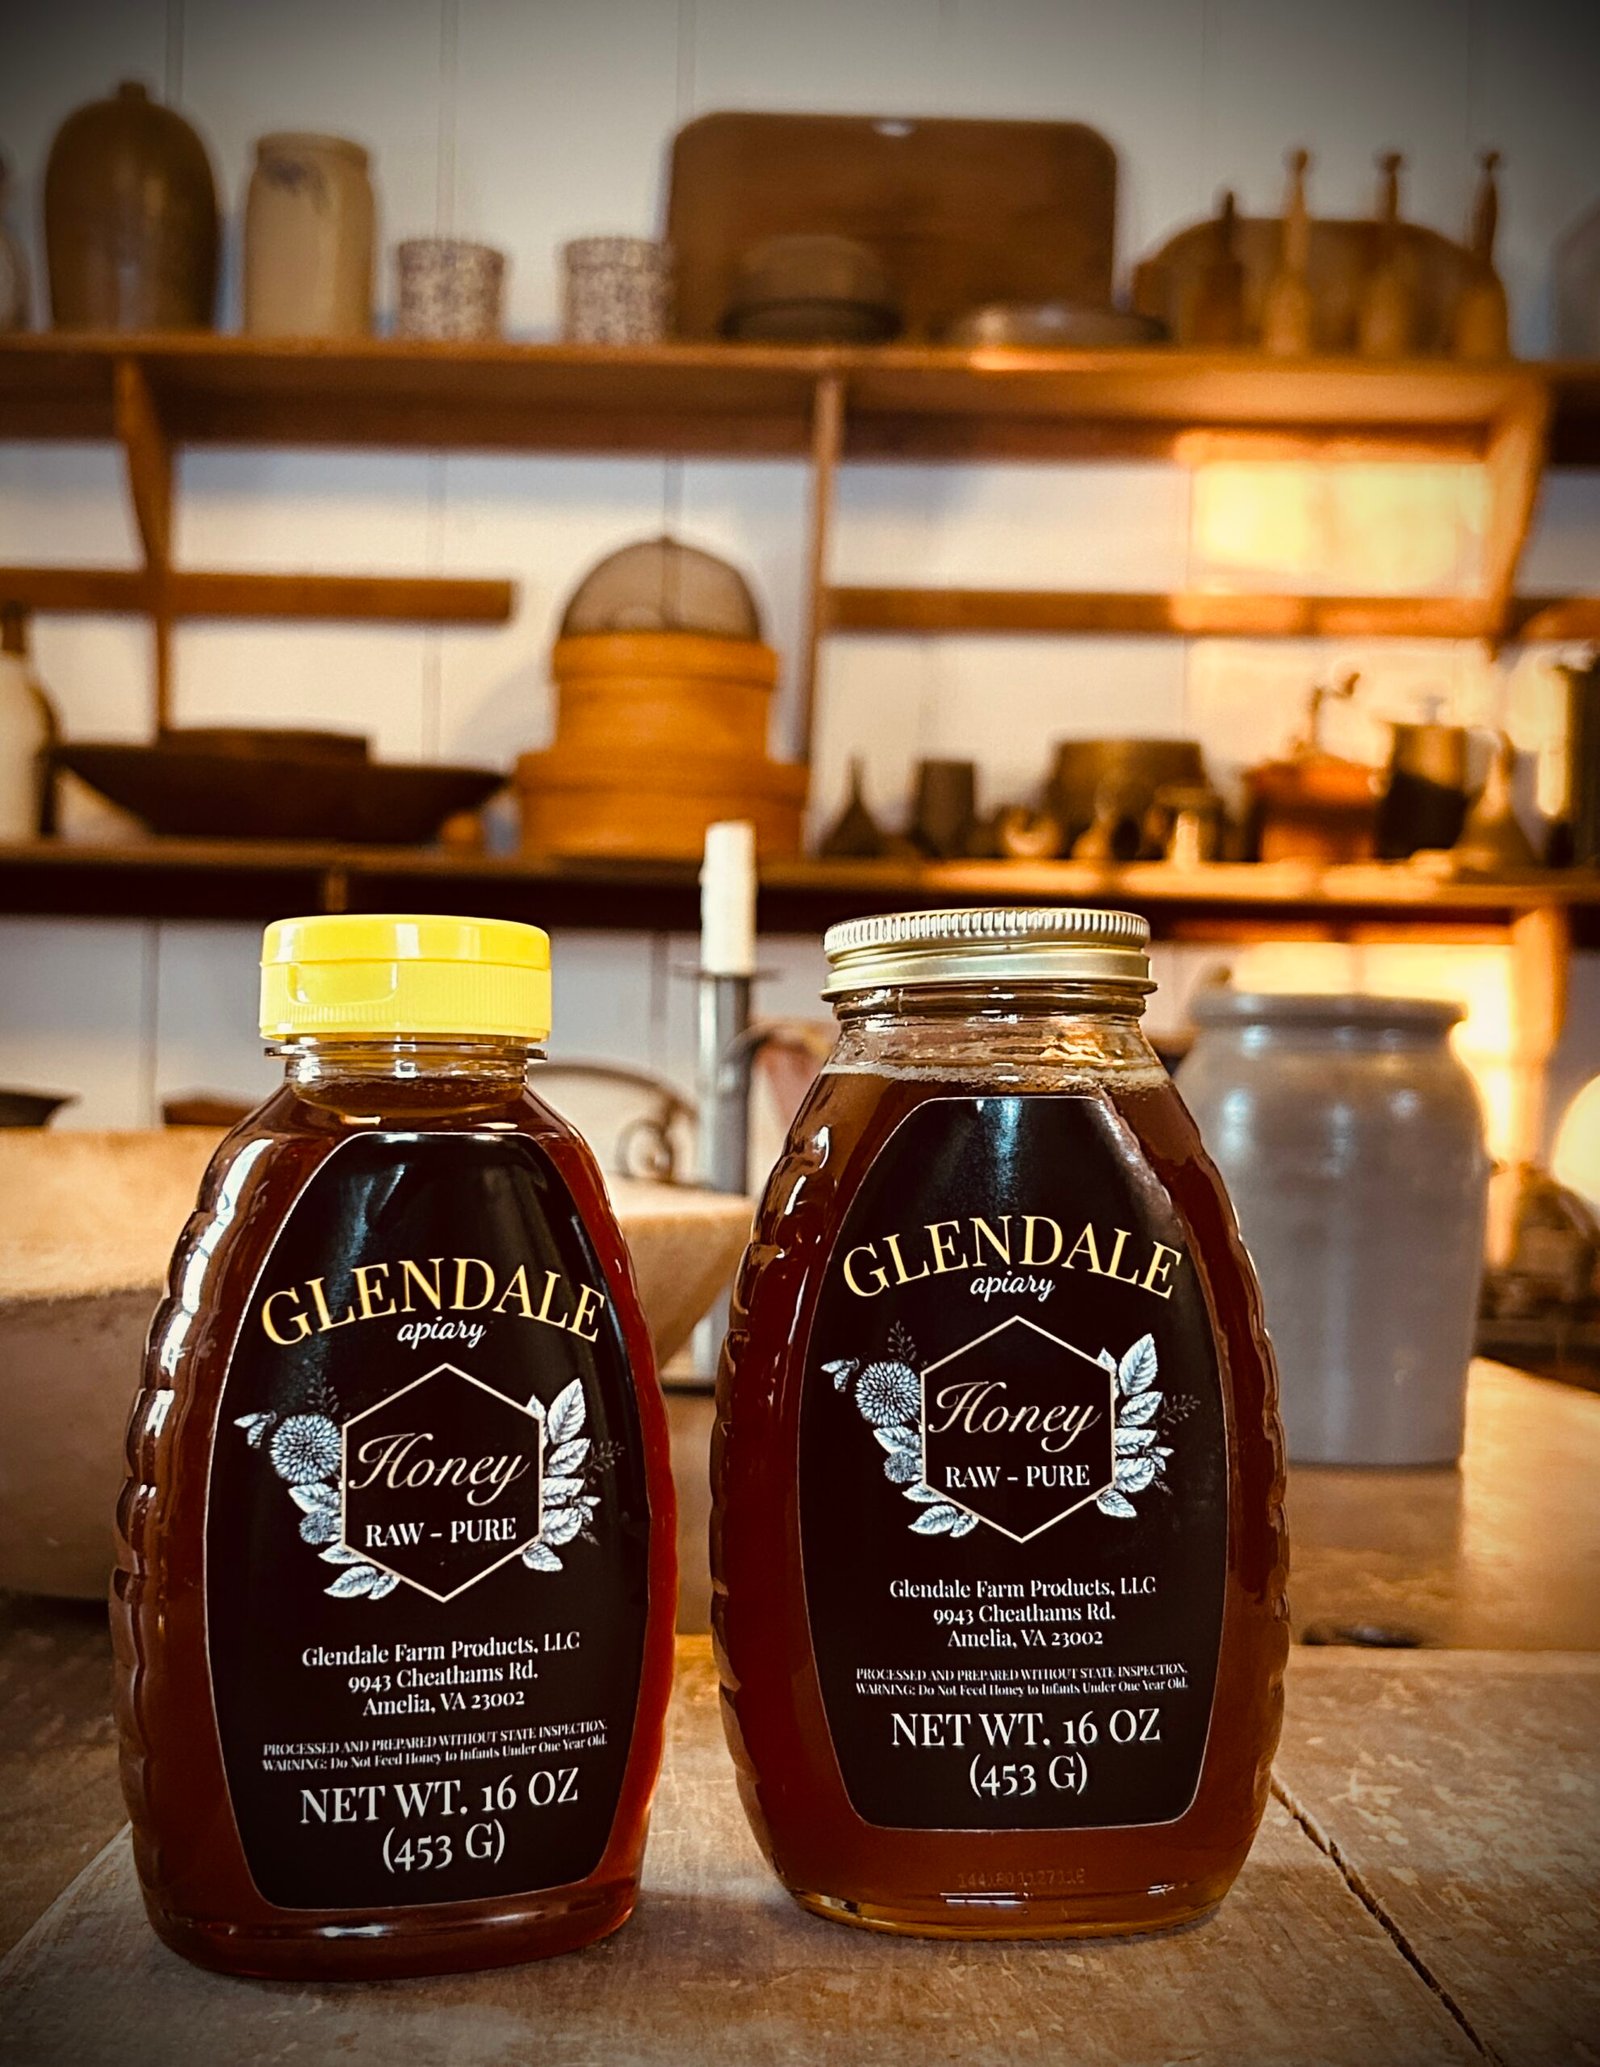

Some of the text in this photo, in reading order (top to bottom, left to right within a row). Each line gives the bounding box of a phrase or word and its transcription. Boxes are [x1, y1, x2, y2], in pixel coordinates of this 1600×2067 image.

[843, 1215, 1182, 1299] GLENDALE
[261, 1257, 605, 1345] GLENDALE
[970, 1271, 1055, 1302] apiary
[397, 1316, 487, 1349] apiary
[929, 1381, 1101, 1453] Honey
[349, 1433, 530, 1506] Honey
[945, 1467, 1001, 1488] RAW
[1026, 1465, 1090, 1486] PURE
[365, 1522, 424, 1547] RAW
[450, 1518, 516, 1543] PURE
[890, 1576, 1156, 1599] Glendale Farm Products, LLC
[933, 1601, 1116, 1626] 9943 Cheathams Rd.
[302, 1644, 389, 1666] Glendale
[395, 1644, 445, 1662] Farm
[544, 1631, 580, 1652] LLC
[948, 1628, 1103, 1649] Amelia, VA 23002
[348, 1659, 538, 1693] 9943 Cheathams Rd.
[856, 1668, 926, 1681] PROCESSED
[928, 1669, 954, 1681] AND
[957, 1669, 1018, 1681] PREPARED
[1021, 1668, 1076, 1680] WITHOUT
[1080, 1666, 1115, 1679] STATE
[856, 1683, 915, 1695] WARNING:
[919, 1684, 934, 1695] Do
[938, 1685, 956, 1696] Not
[960, 1684, 986, 1695] Feed
[990, 1684, 1024, 1698] Honey
[1028, 1684, 1039, 1695] to
[1042, 1683, 1080, 1695] Infants
[1083, 1681, 1116, 1694] Under
[1118, 1680, 1140, 1692] One
[1142, 1680, 1165, 1690] Year
[363, 1691, 524, 1716] Amelia, VA 23002
[263, 1743, 340, 1756] PROCESSED
[341, 1740, 369, 1753] AND
[372, 1735, 437, 1750] PREPARED
[437, 1731, 498, 1746] WITHOUT
[500, 1728, 536, 1741] STATE
[891, 1708, 1160, 1748] NET WT. 16 OZ
[262, 1759, 327, 1771] WARNING:
[330, 1758, 348, 1769] Do
[351, 1756, 371, 1768] Not
[375, 1753, 402, 1766] Feed
[406, 1752, 441, 1765] Honey
[445, 1751, 457, 1762] to
[460, 1746, 500, 1760] Infants
[503, 1743, 537, 1757] Under
[539, 1741, 560, 1753] One
[562, 1738, 585, 1750] Year
[970, 1752, 1088, 1798] (453 G)
[300, 1767, 579, 1824] NET WT. 16 OZ
[383, 1819, 505, 1873] (453 G)
